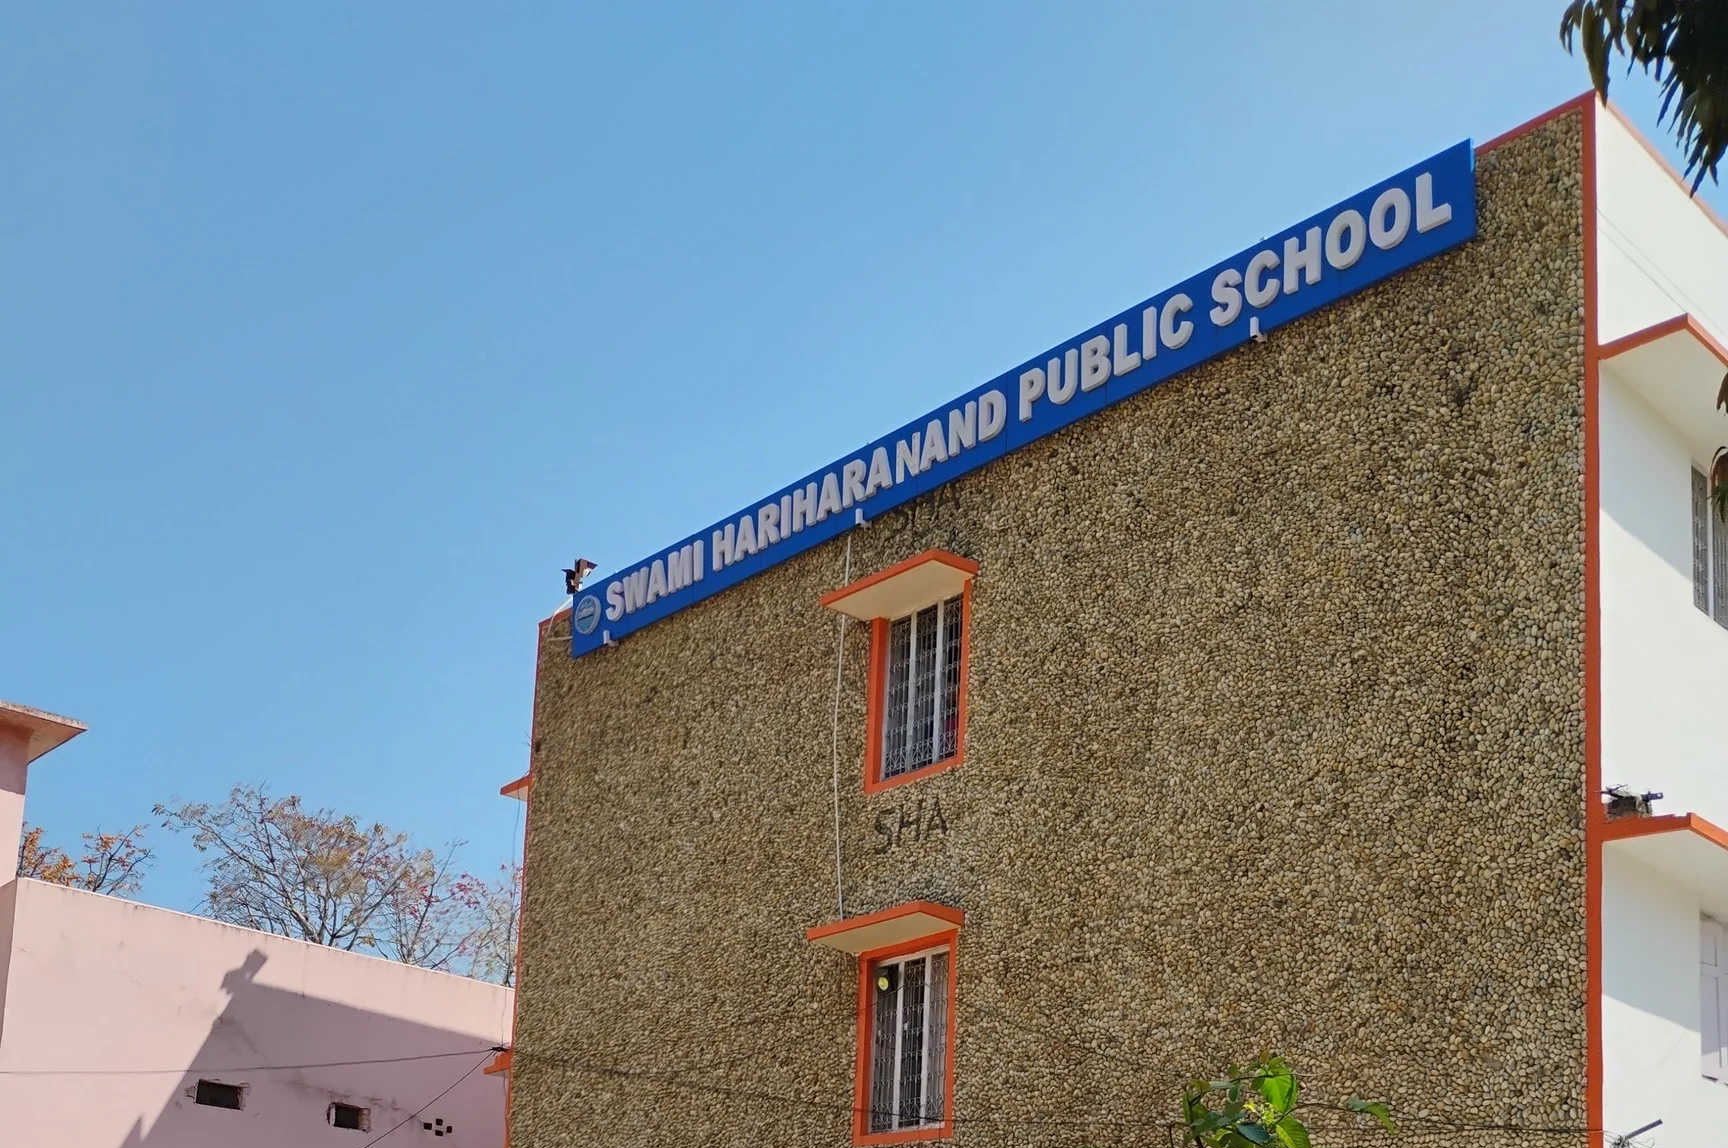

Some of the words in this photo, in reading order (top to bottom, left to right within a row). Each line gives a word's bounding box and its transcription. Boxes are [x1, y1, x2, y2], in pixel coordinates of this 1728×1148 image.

[606, 539, 704, 622] SWAMI
[712, 389, 1006, 572] HARIHARANAND
[1019, 293, 1193, 422] PUBLIC
[1209, 171, 1452, 327] SCHOOL
[875, 797, 949, 854] SHA
